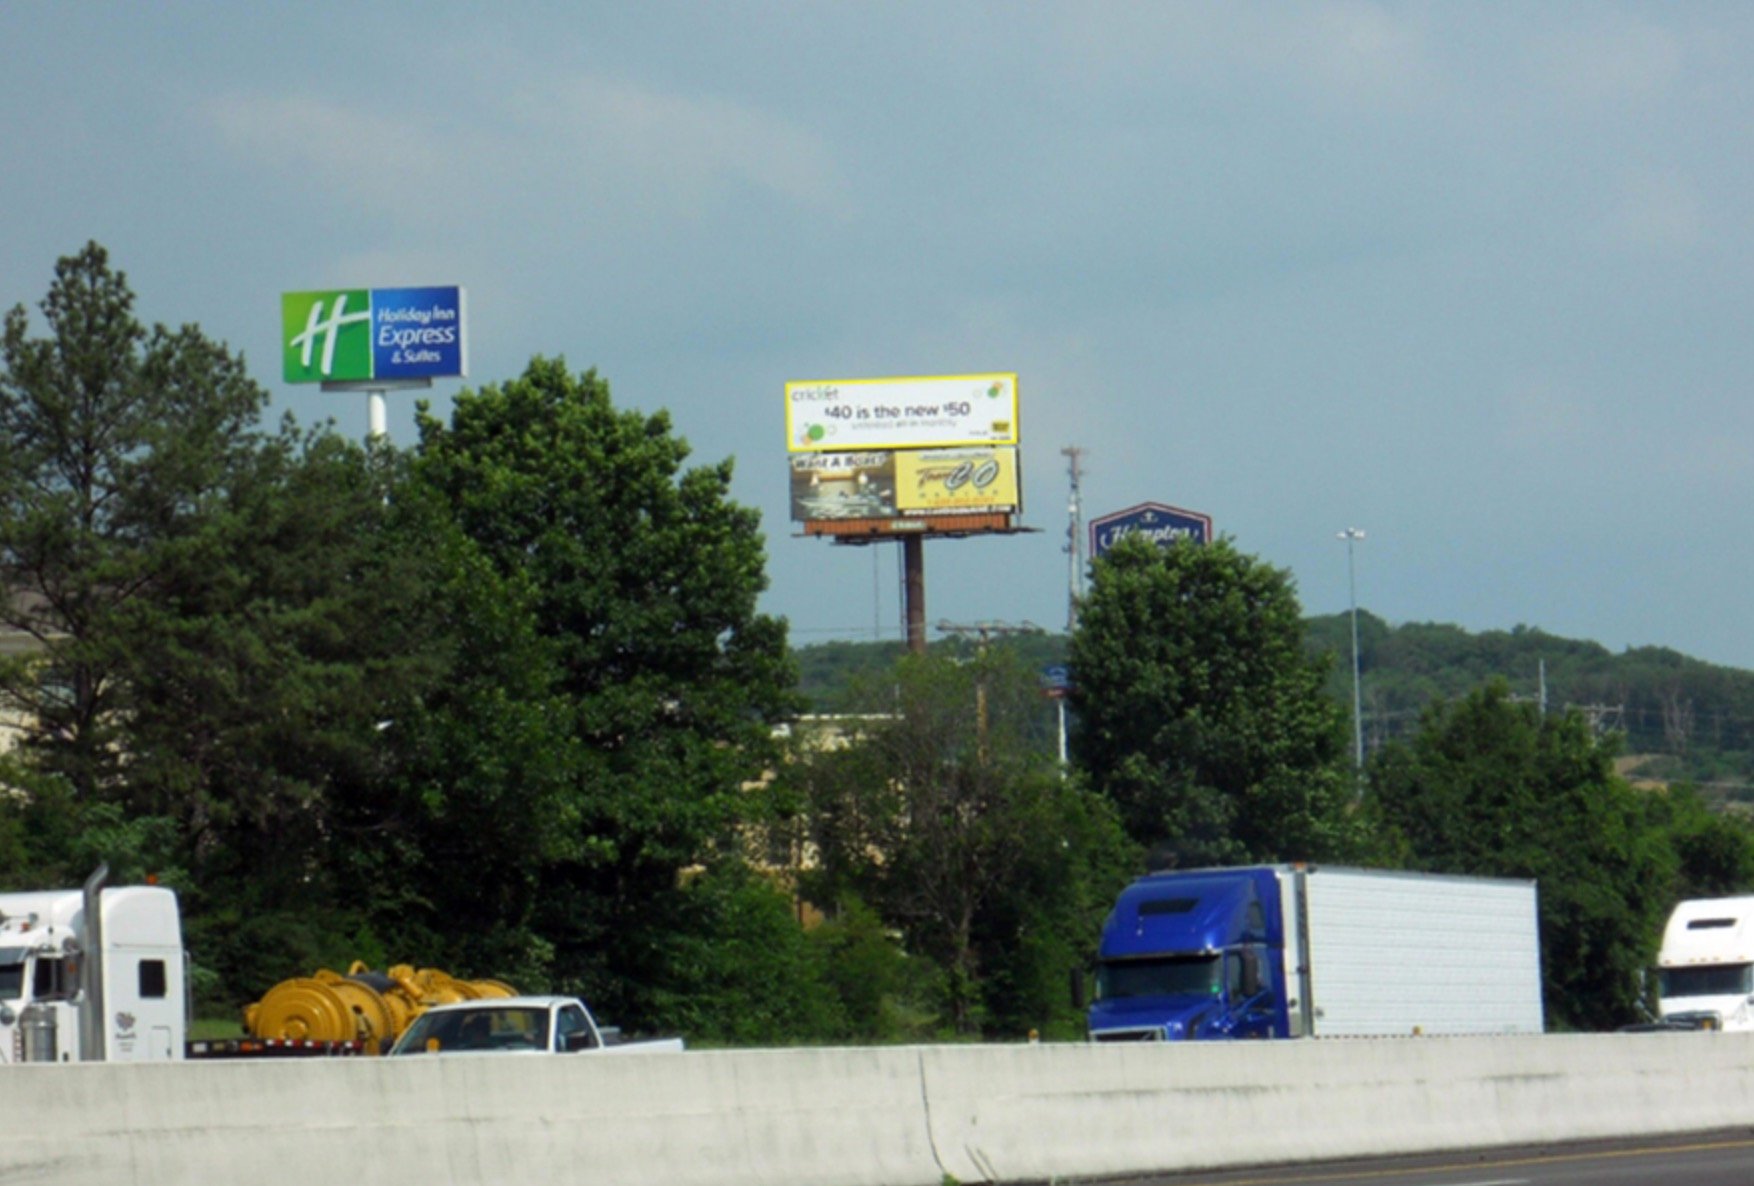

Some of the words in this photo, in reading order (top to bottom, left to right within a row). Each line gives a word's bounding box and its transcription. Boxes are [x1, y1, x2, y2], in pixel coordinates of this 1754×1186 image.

[378, 307, 431, 324] Holiday
[432, 304, 455, 320] Inn
[378, 325, 455, 348] Express
[391, 352, 402, 364] &
[403, 349, 441, 363] Suites
[791, 384, 839, 402] cricket
[824, 404, 852, 420] $40
[856, 404, 870, 419] is
[874, 402, 901, 418] the
[904, 403, 940, 417] new
[943, 401, 971, 416] $50
